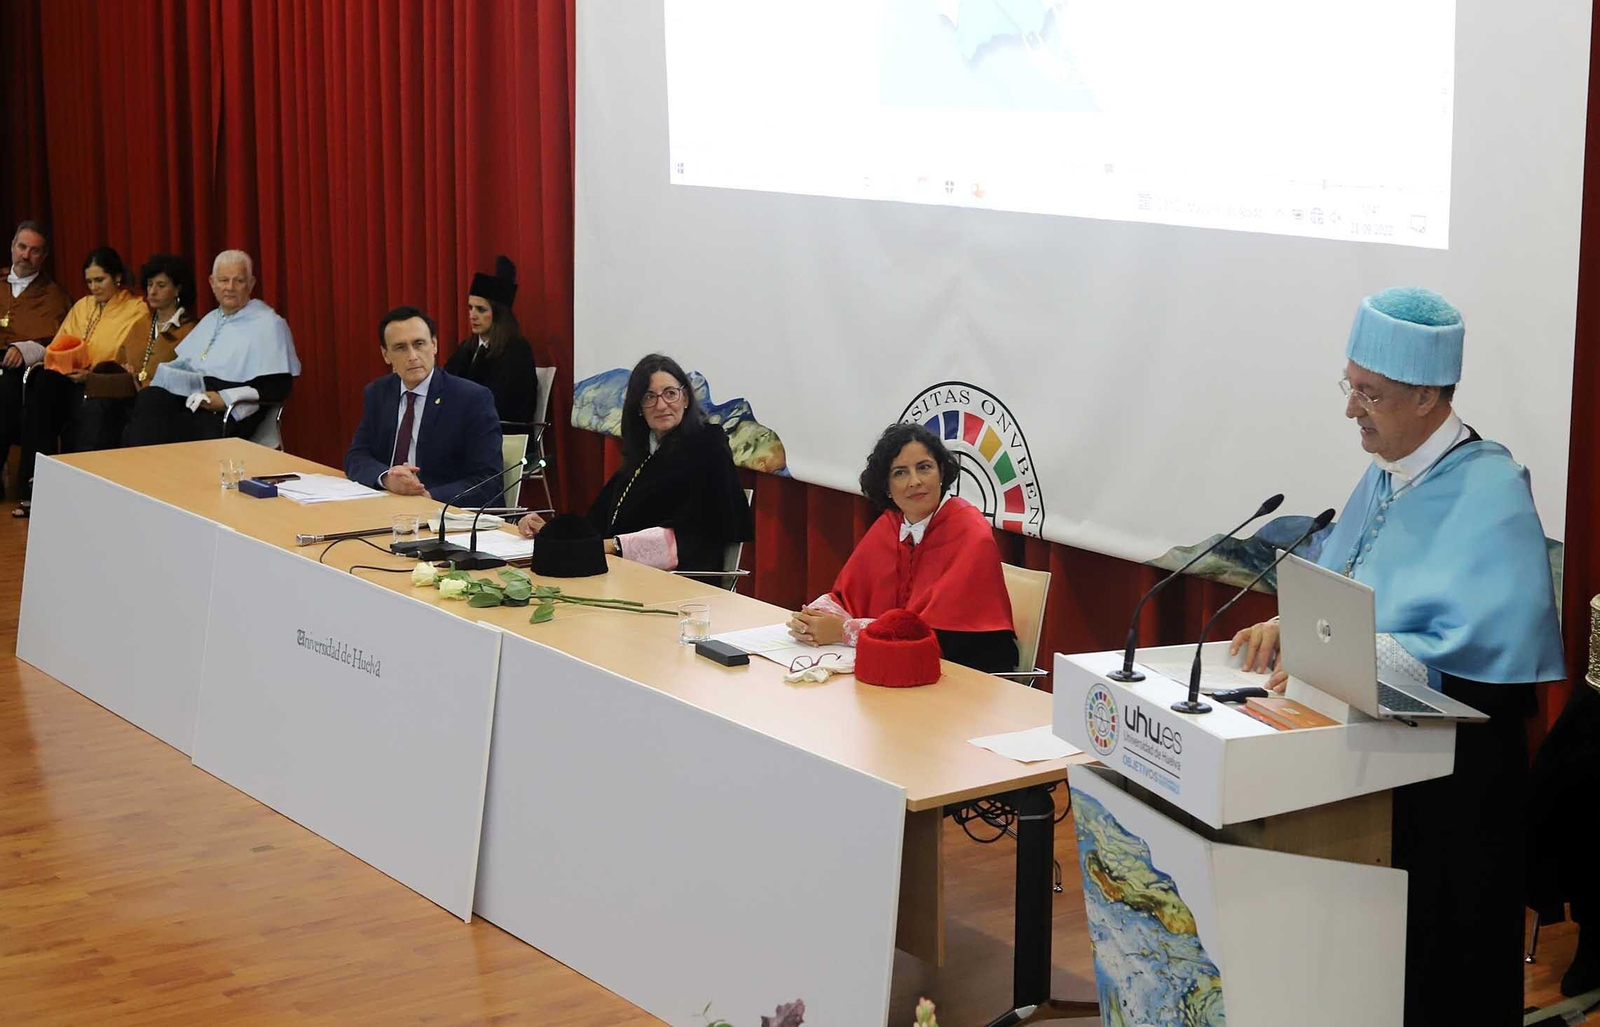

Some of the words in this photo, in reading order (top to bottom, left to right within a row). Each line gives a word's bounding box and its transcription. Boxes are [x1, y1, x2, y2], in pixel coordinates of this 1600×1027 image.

[981, 399, 1040, 536] ONVBEN
[297, 628, 340, 661] Universidad
[340, 644, 352, 665] de
[352, 647, 381, 678] Huelva
[1124, 705, 1182, 755] uhu.es
